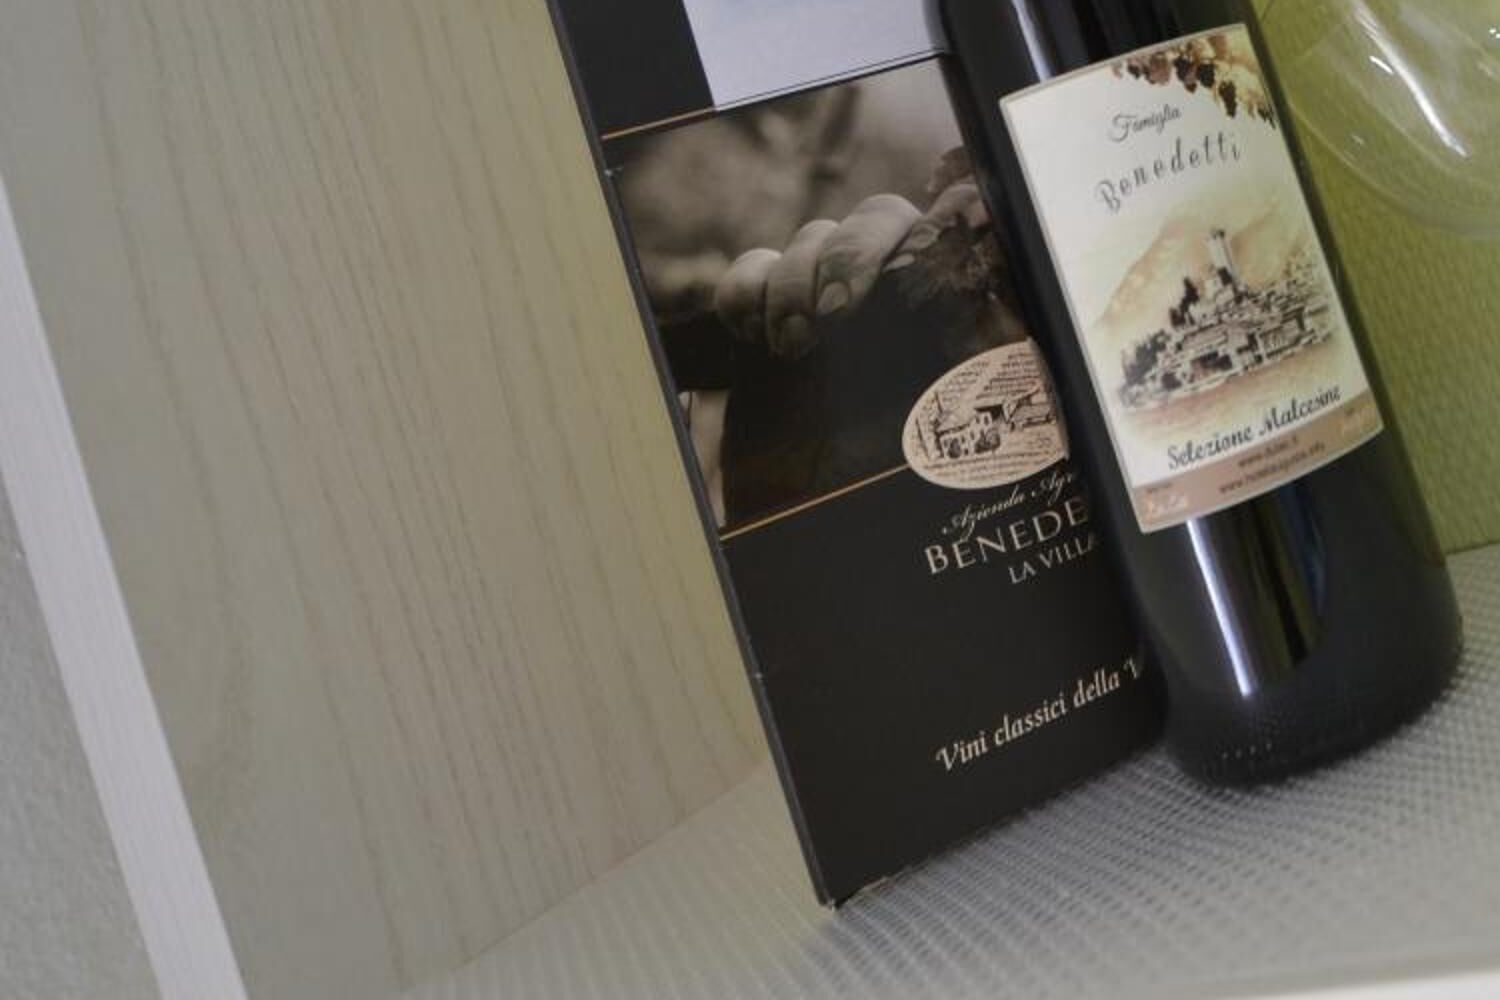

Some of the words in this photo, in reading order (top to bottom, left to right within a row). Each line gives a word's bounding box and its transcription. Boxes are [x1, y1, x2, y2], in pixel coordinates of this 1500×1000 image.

[1111, 103, 1182, 142] Famiglia
[1095, 131, 1240, 215] Benedetti
[1166, 426, 1253, 471] Selezione
[1258, 385, 1341, 437] Malcesine
[924, 497, 1089, 575] BENEDE
[941, 483, 1026, 541] Azienda
[1008, 560, 1036, 585] LA
[935, 730, 989, 771] Vini
[993, 692, 1068, 747] classici
[1072, 669, 1121, 708] della
